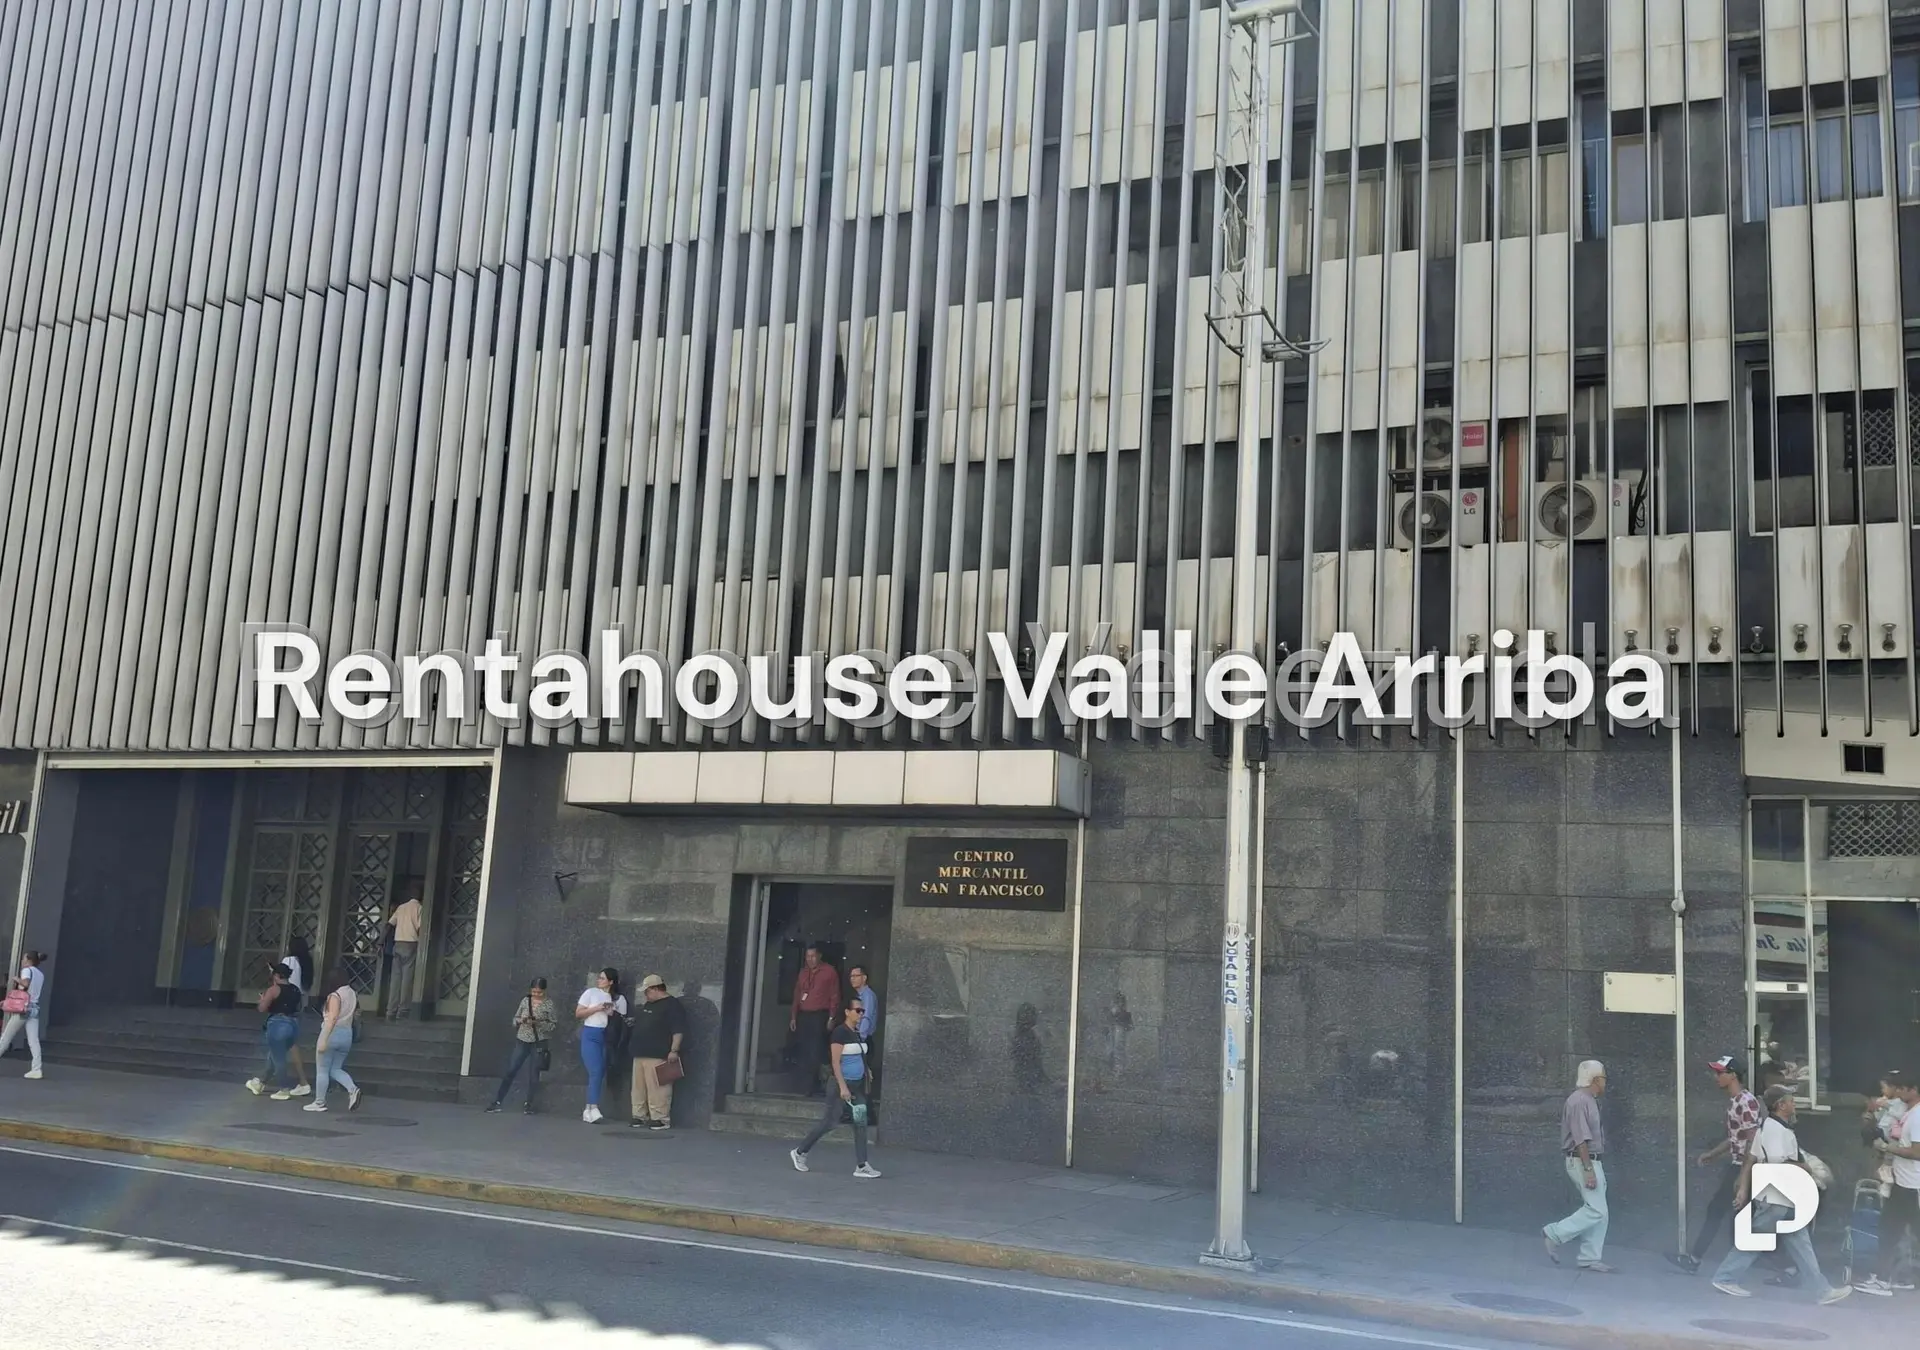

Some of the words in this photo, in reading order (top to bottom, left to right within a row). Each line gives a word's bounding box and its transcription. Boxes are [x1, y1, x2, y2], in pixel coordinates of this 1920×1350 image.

[1464, 507, 1476, 515] LG
[0, 800, 20, 833] il
[954, 851, 1015, 862] CENTRO
[939, 867, 1028, 879] MERCANTIL
[921, 882, 949, 894] SAN
[959, 884, 1044, 896] FRANCISCO
[1225, 941, 1238, 970] VOTA
